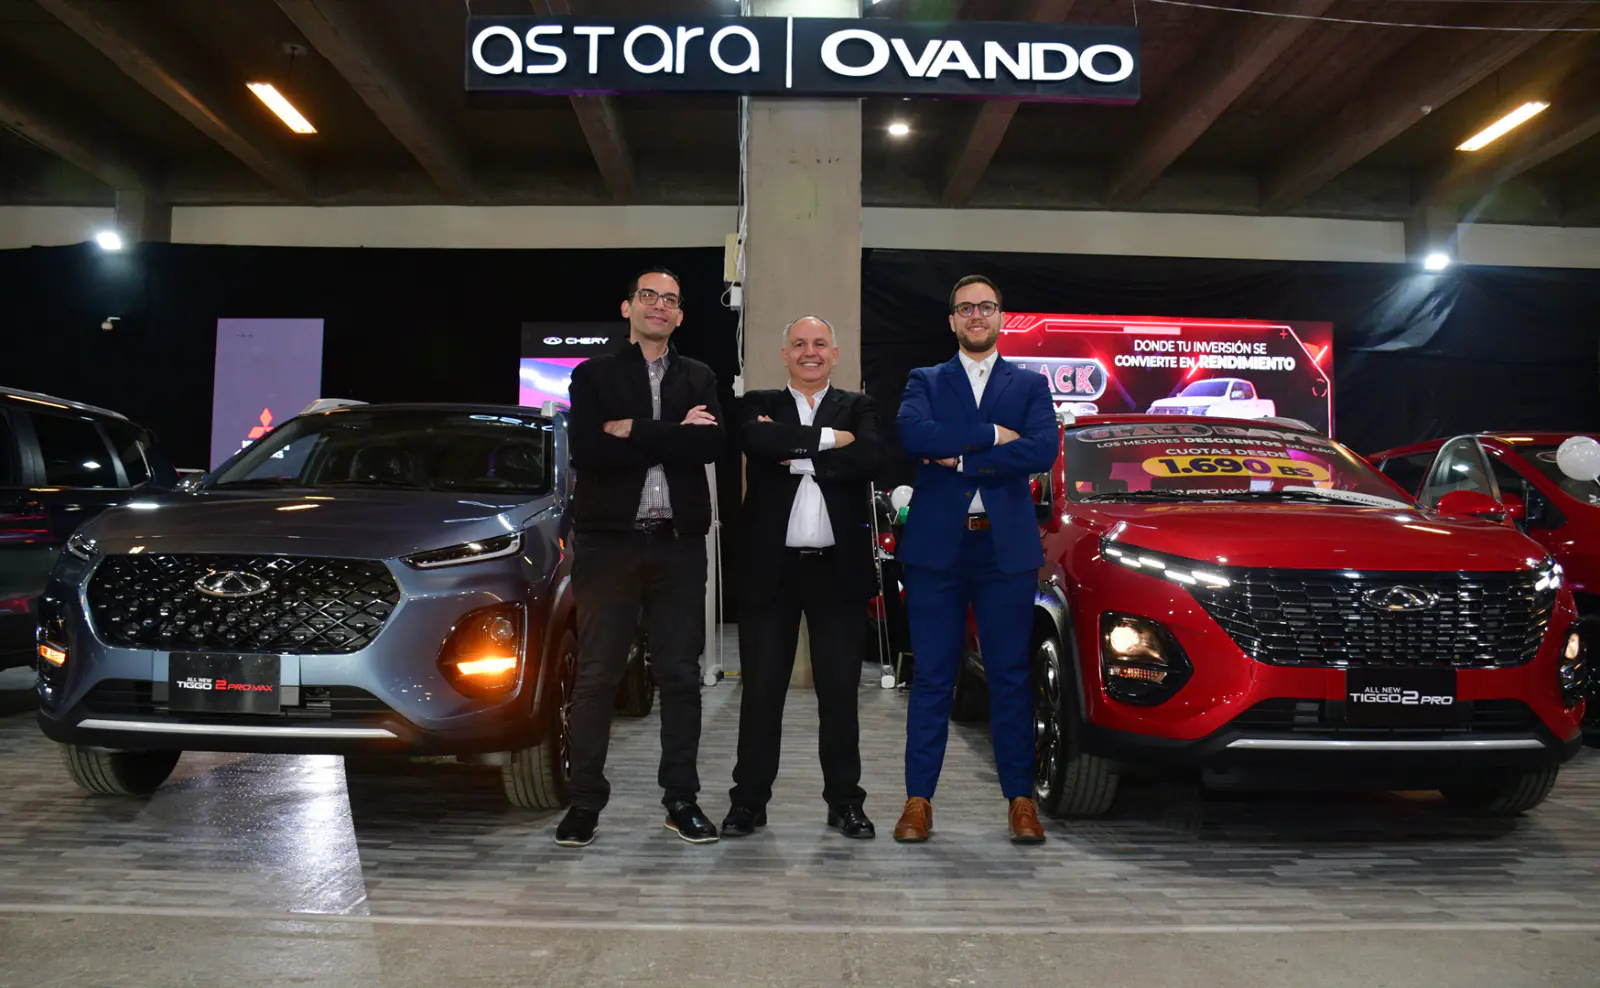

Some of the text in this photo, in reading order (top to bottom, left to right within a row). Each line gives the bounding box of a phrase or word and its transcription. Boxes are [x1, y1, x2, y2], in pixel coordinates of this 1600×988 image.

[820, 28, 1134, 83] OVANDO
[565, 337, 609, 345] CHERY
[1134, 339, 1267, 354] DONDE TU INVERSIÓN SE
[1114, 355, 1296, 371] CONVIERTE EN RENDIMIENTO
[1091, 424, 1199, 440] BLACK
[1123, 438, 1181, 446] MEJORES
[1183, 436, 1283, 447] DESCUENTOS
[1165, 448, 1291, 459] CUOTAS DESDE
[1158, 458, 1315, 478] 1.690 BS
[176, 679, 273, 692] TIGGO 2 PRO MAX
[1420, 695, 1453, 705] PRO
